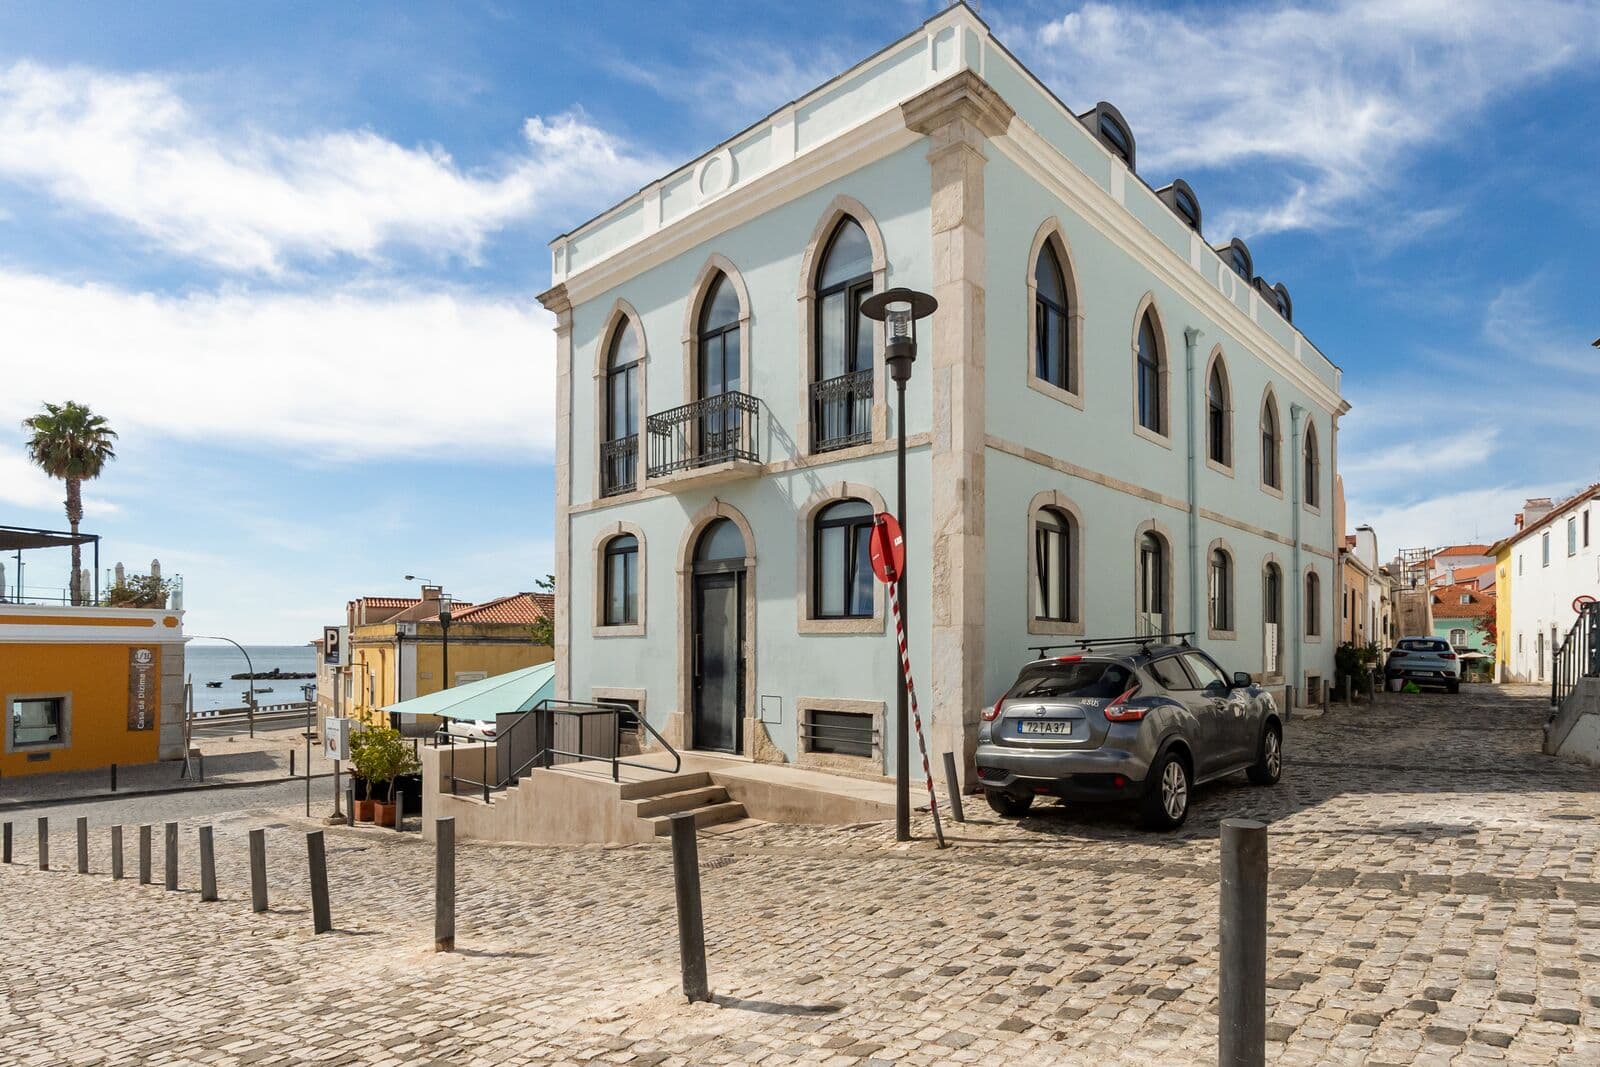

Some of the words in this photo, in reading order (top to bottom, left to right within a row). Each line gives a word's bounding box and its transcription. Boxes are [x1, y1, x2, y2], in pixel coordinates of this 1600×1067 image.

[327, 630, 337, 653] P
[138, 700, 145, 709] da
[137, 711, 145, 729] Casa
